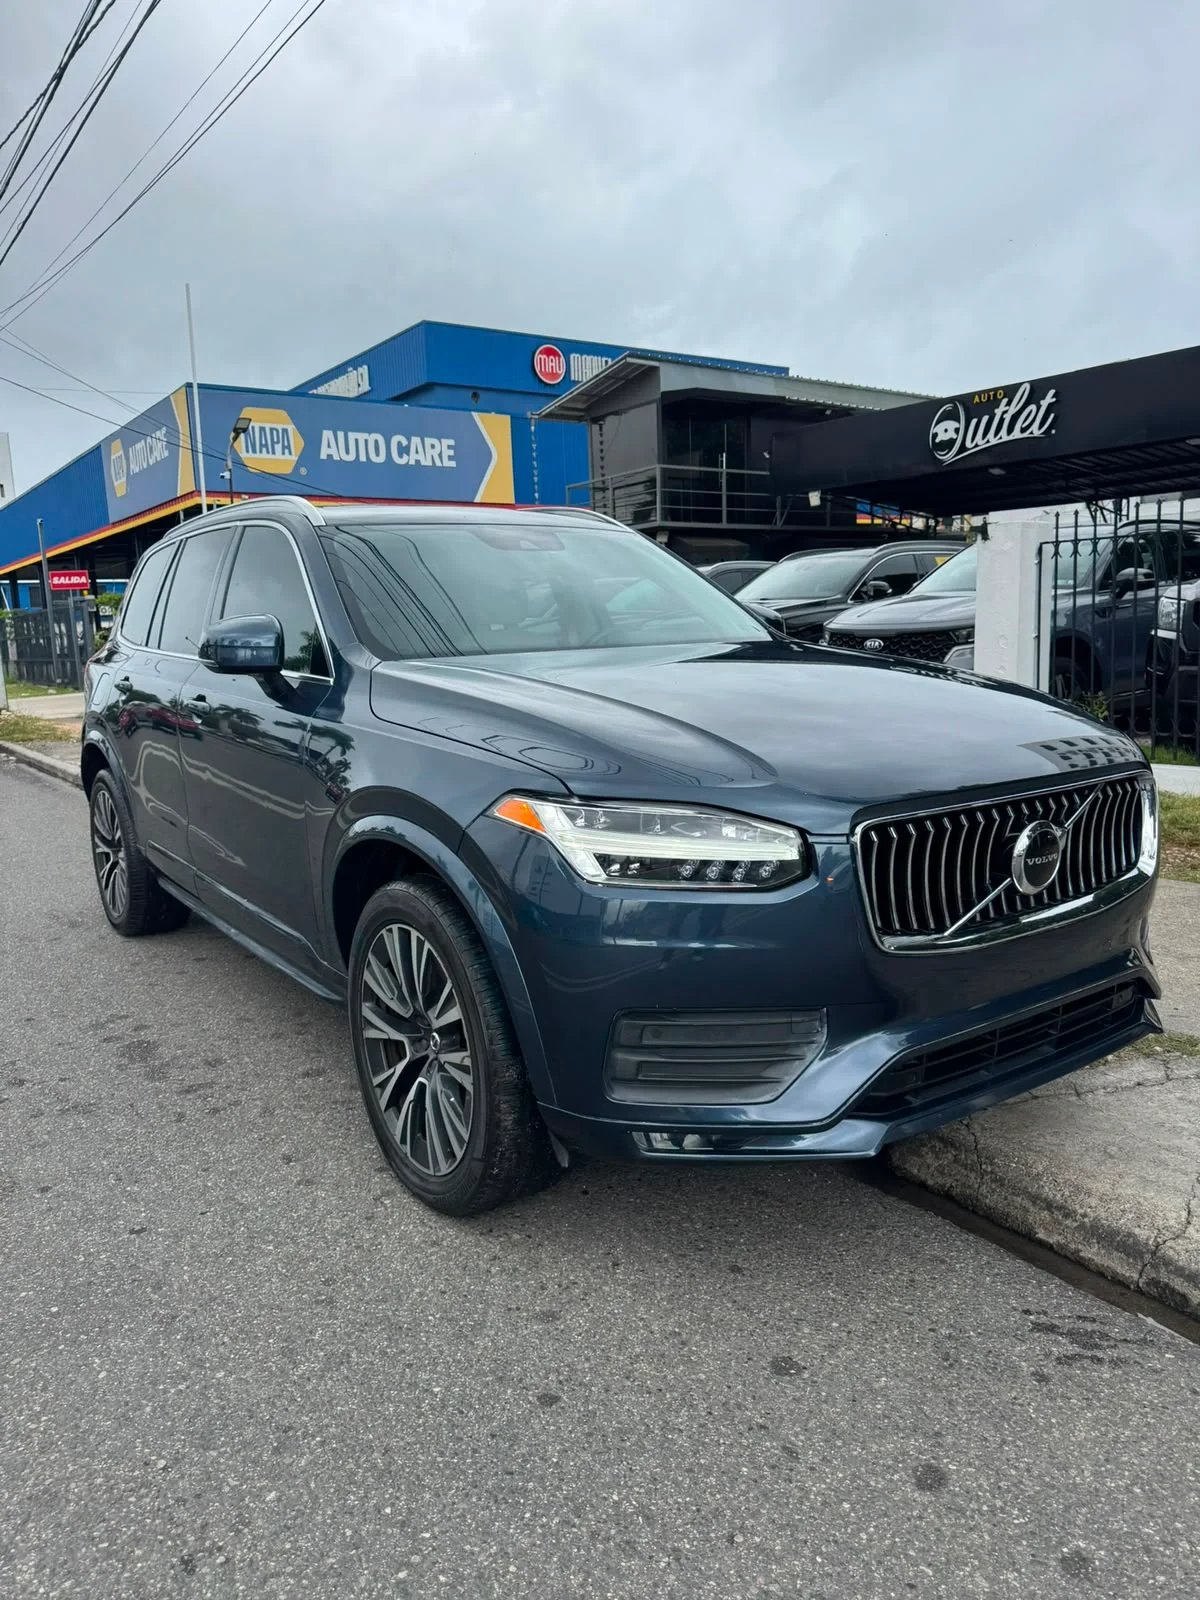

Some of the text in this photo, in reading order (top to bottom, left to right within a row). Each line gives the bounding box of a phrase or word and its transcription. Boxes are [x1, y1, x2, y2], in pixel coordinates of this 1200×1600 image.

[537, 353, 563, 374] MAU
[973, 389, 1005, 405] AUTO
[129, 439, 148, 476] AUTO
[146, 426, 169, 466] CARE
[244, 425, 457, 467] NAPA AUTO CARE
[52, 575, 87, 585] SALIDA
[1025, 852, 1058, 866] VOLVO
